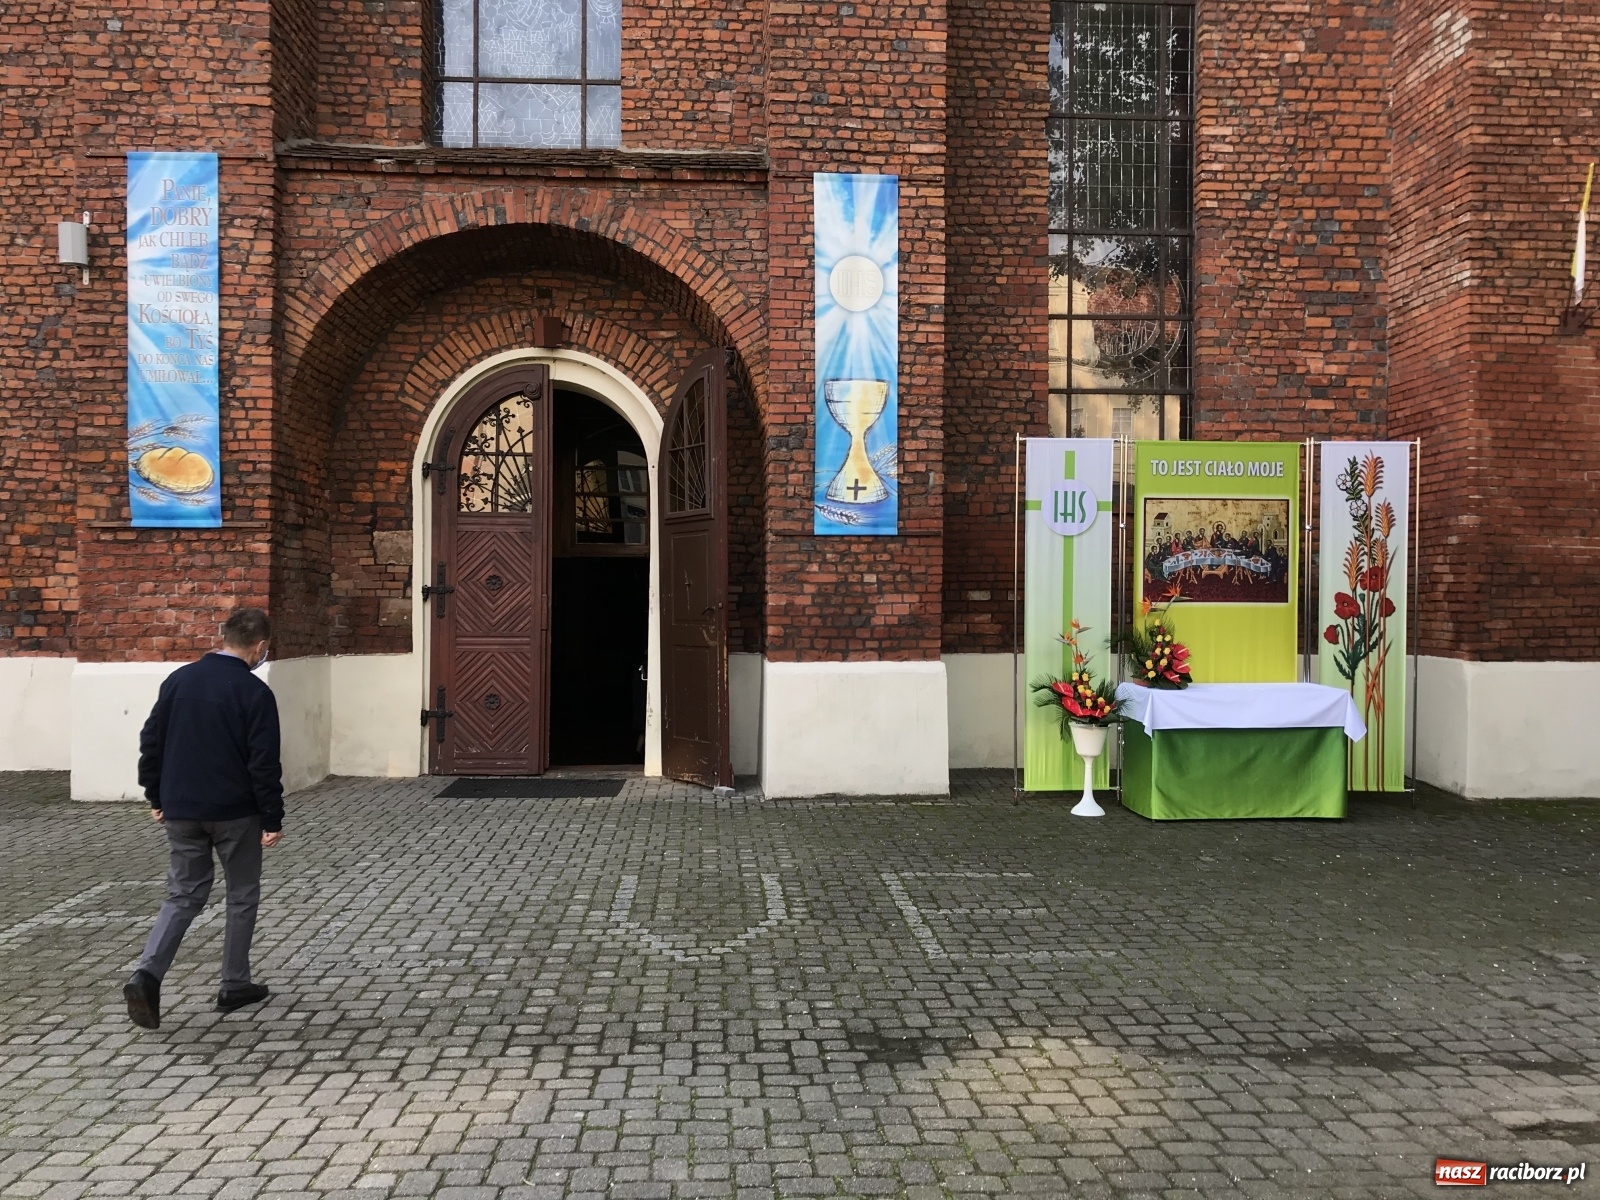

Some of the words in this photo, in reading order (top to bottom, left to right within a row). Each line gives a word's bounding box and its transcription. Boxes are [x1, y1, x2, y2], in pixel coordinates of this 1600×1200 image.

[162, 179, 211, 205] PANIE,
[150, 206, 213, 226] DOBRY
[138, 235, 157, 249] JAK
[144, 274, 213, 288] UWIELBIONY
[157, 291, 172, 302] OD
[175, 291, 213, 303] SWEGO
[138, 303, 213, 325] KOŚCIOŁA,
[165, 337, 181, 348] BO
[185, 328, 213, 350] TYŚ
[138, 354, 153, 365] DO
[194, 355, 213, 366] NAS
[1150, 459, 1168, 476] TO
[1171, 459, 1201, 477] JEST
[1205, 459, 1245, 477] CIAŁO
[1247, 460, 1284, 477] MOJE
[1053, 490, 1087, 524] IHS
